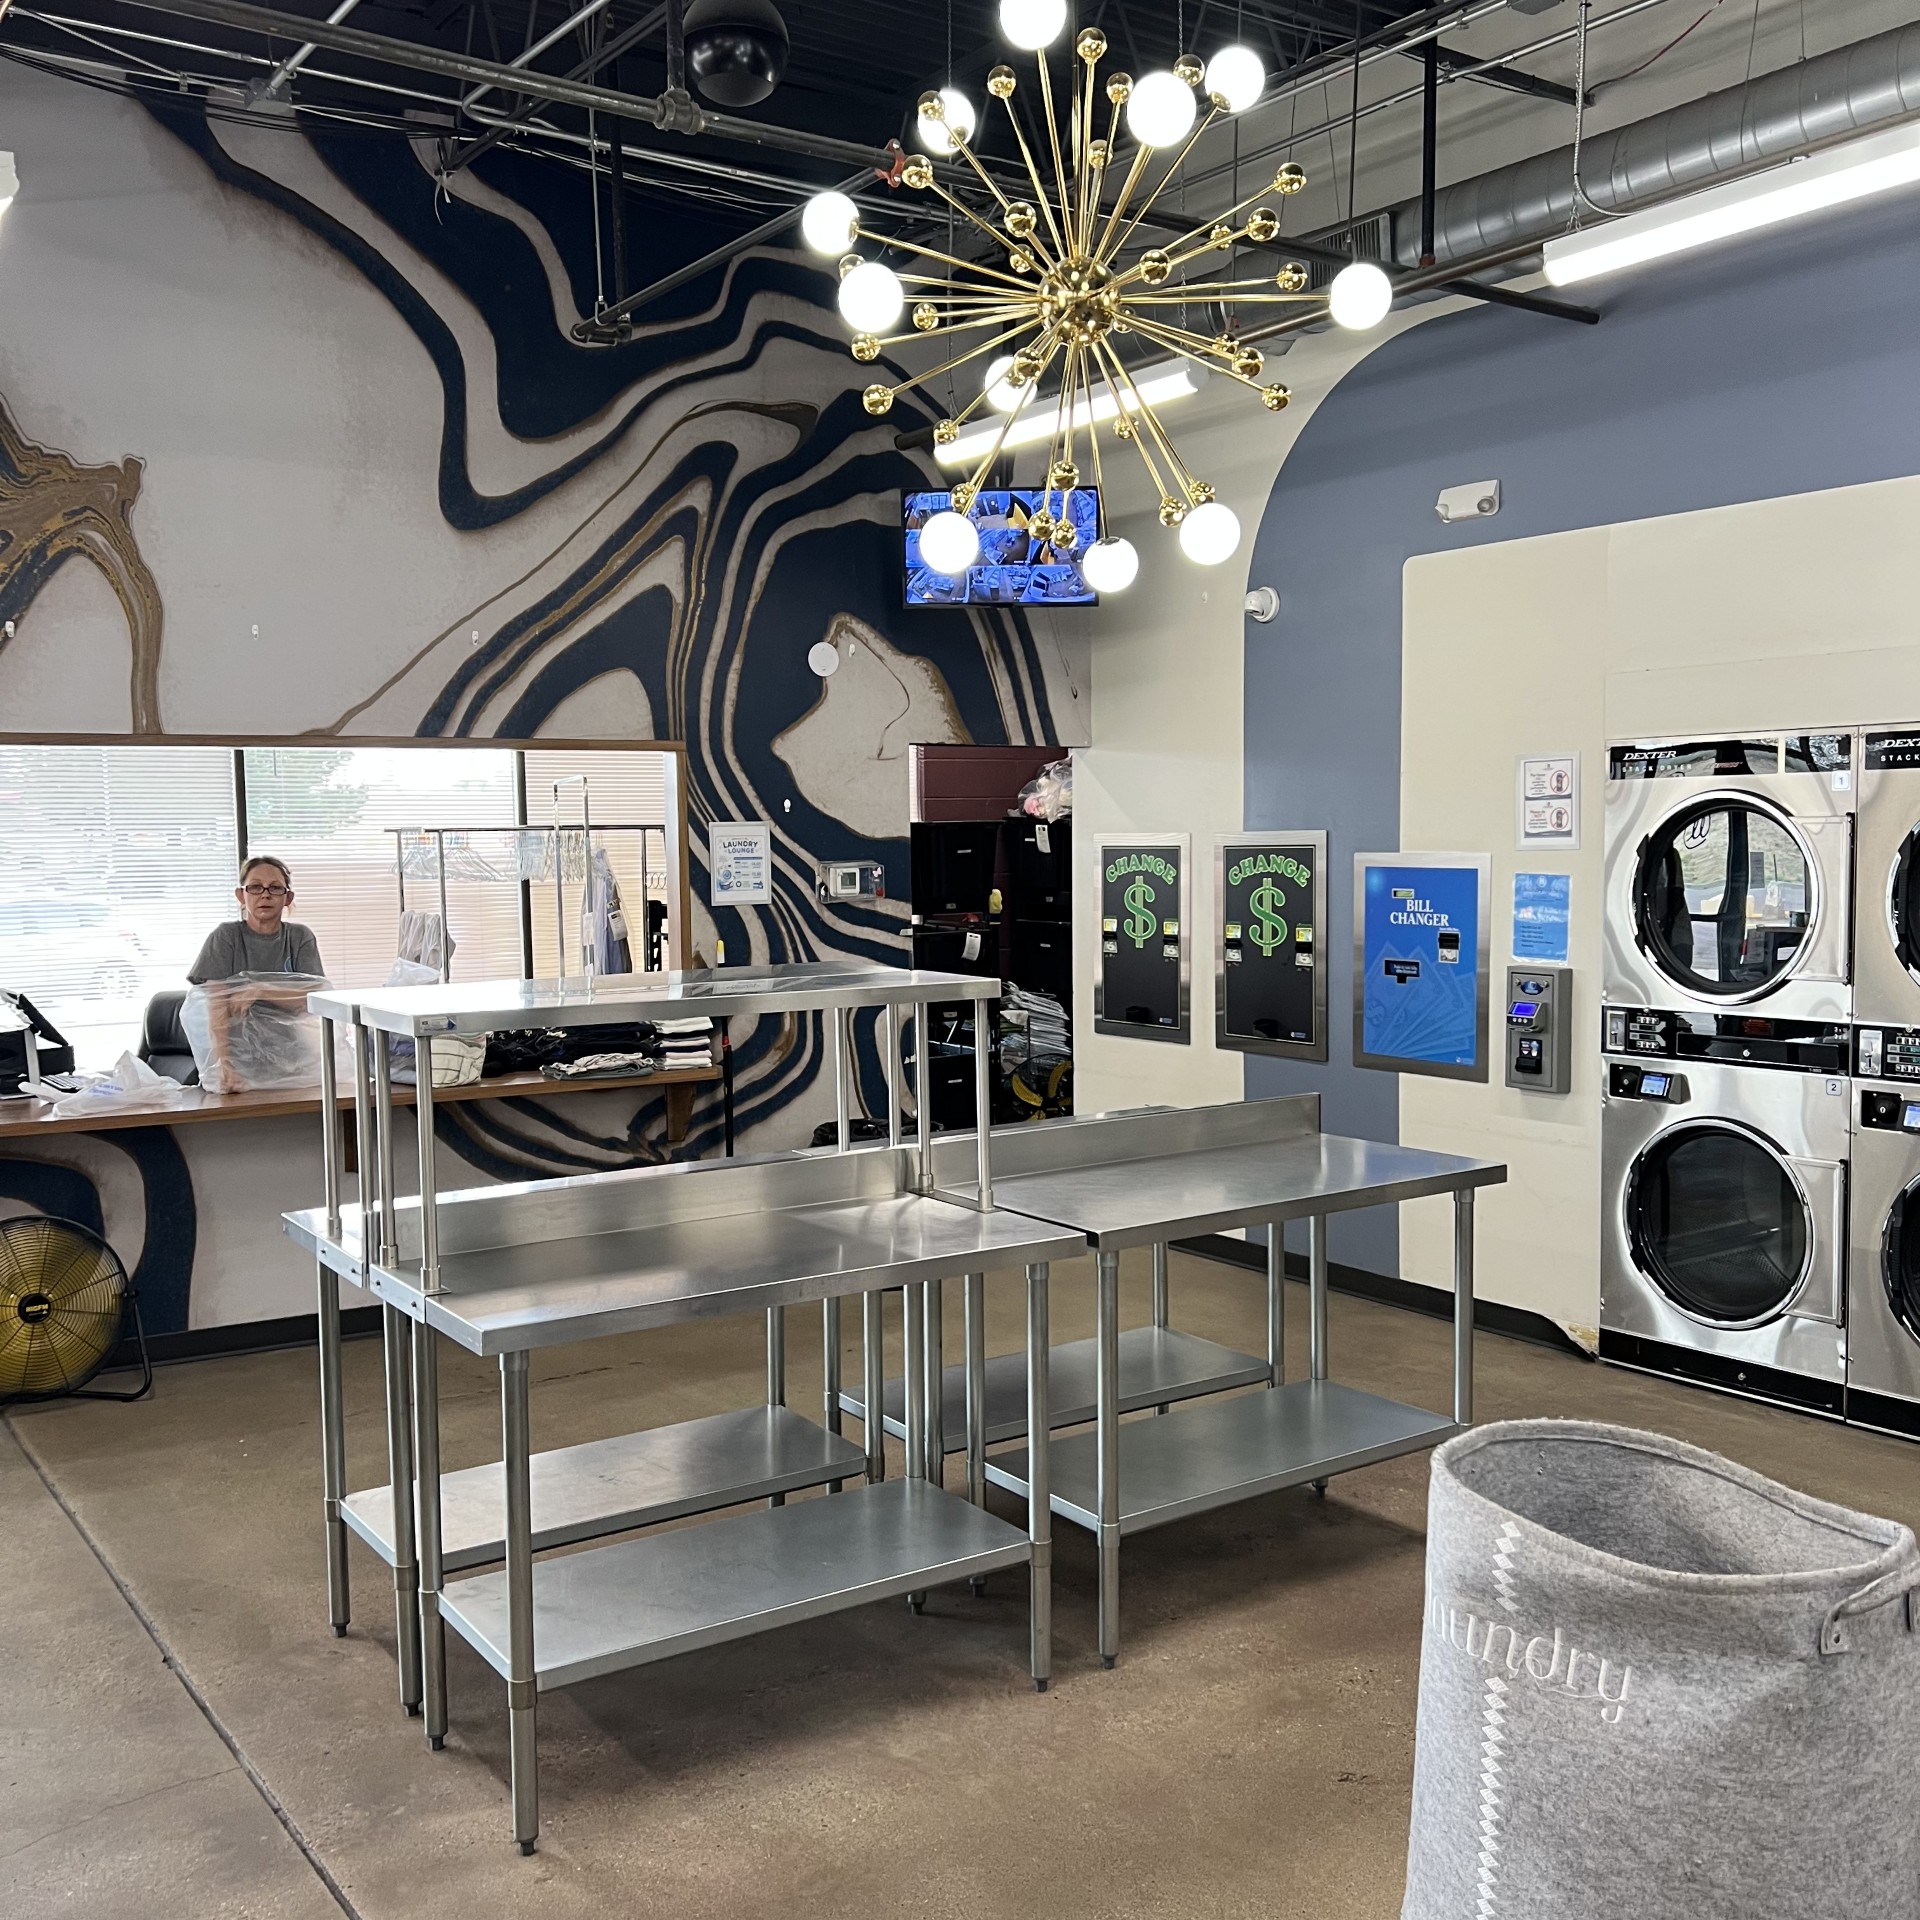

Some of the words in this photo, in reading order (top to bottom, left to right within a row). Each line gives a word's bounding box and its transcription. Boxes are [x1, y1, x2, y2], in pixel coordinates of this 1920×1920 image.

[1623, 751, 1676, 760] DEXTER
[1881, 754, 1920, 762] STACK
[1106, 854, 1177, 885] CHANGE
[1228, 855, 1311, 887] CHANGE
[1123, 876, 1157, 948] $
[1248, 878, 1288, 956] $
[1407, 900, 1434, 912] BILL
[1390, 912, 1450, 926] CHANGER
